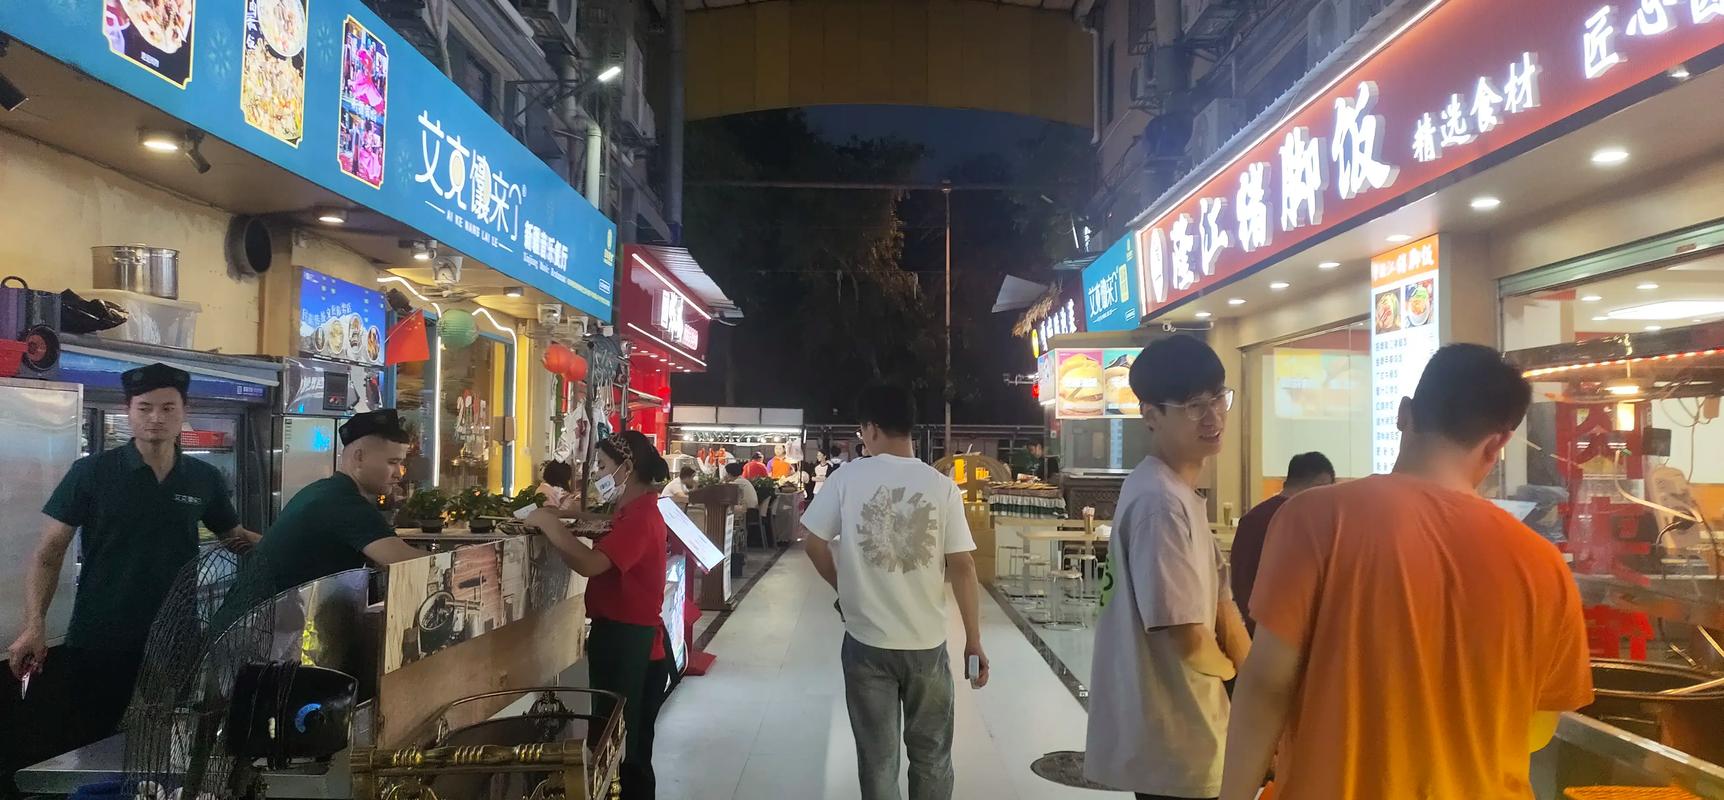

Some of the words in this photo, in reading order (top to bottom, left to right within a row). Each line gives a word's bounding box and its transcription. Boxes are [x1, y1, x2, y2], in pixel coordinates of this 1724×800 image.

[1584, 0, 1724, 79] 匠心
[1412, 52, 1537, 162] 精选食材
[1170, 82, 1393, 291] 隆江猪脚饭
